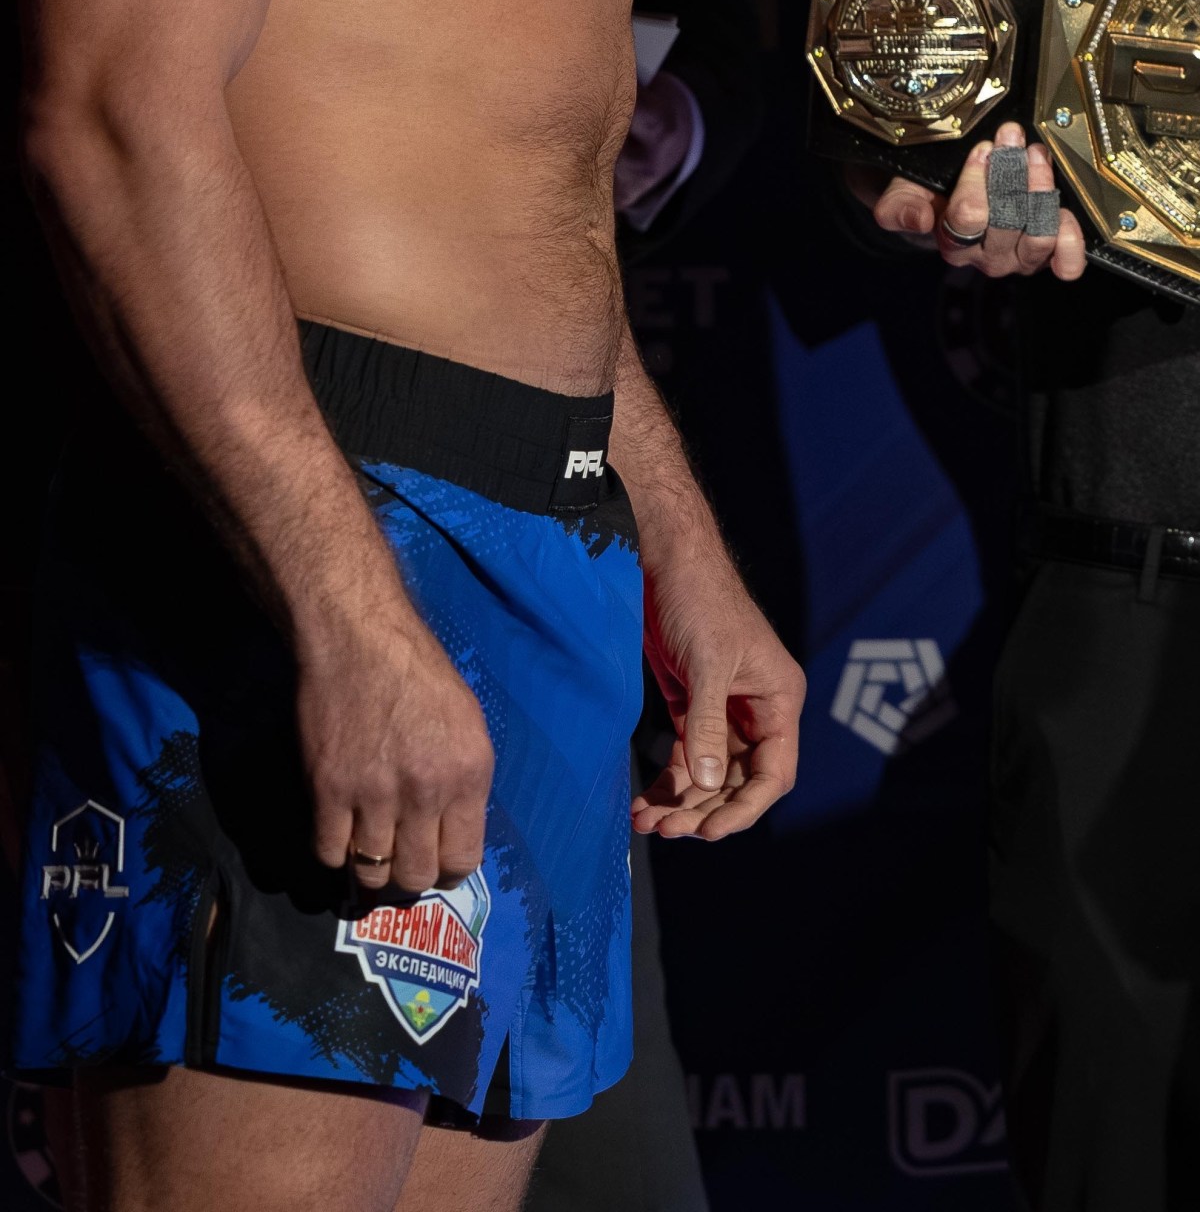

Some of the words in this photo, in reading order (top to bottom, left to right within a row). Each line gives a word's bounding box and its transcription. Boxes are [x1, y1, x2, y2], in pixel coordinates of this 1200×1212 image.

[564, 449, 605, 479] PFL
[40, 863, 130, 900] PFL
[355, 901, 444, 956] СЕВЕРНЫЙ
[375, 950, 467, 990] ЭКСПЕДИЦИЯ
